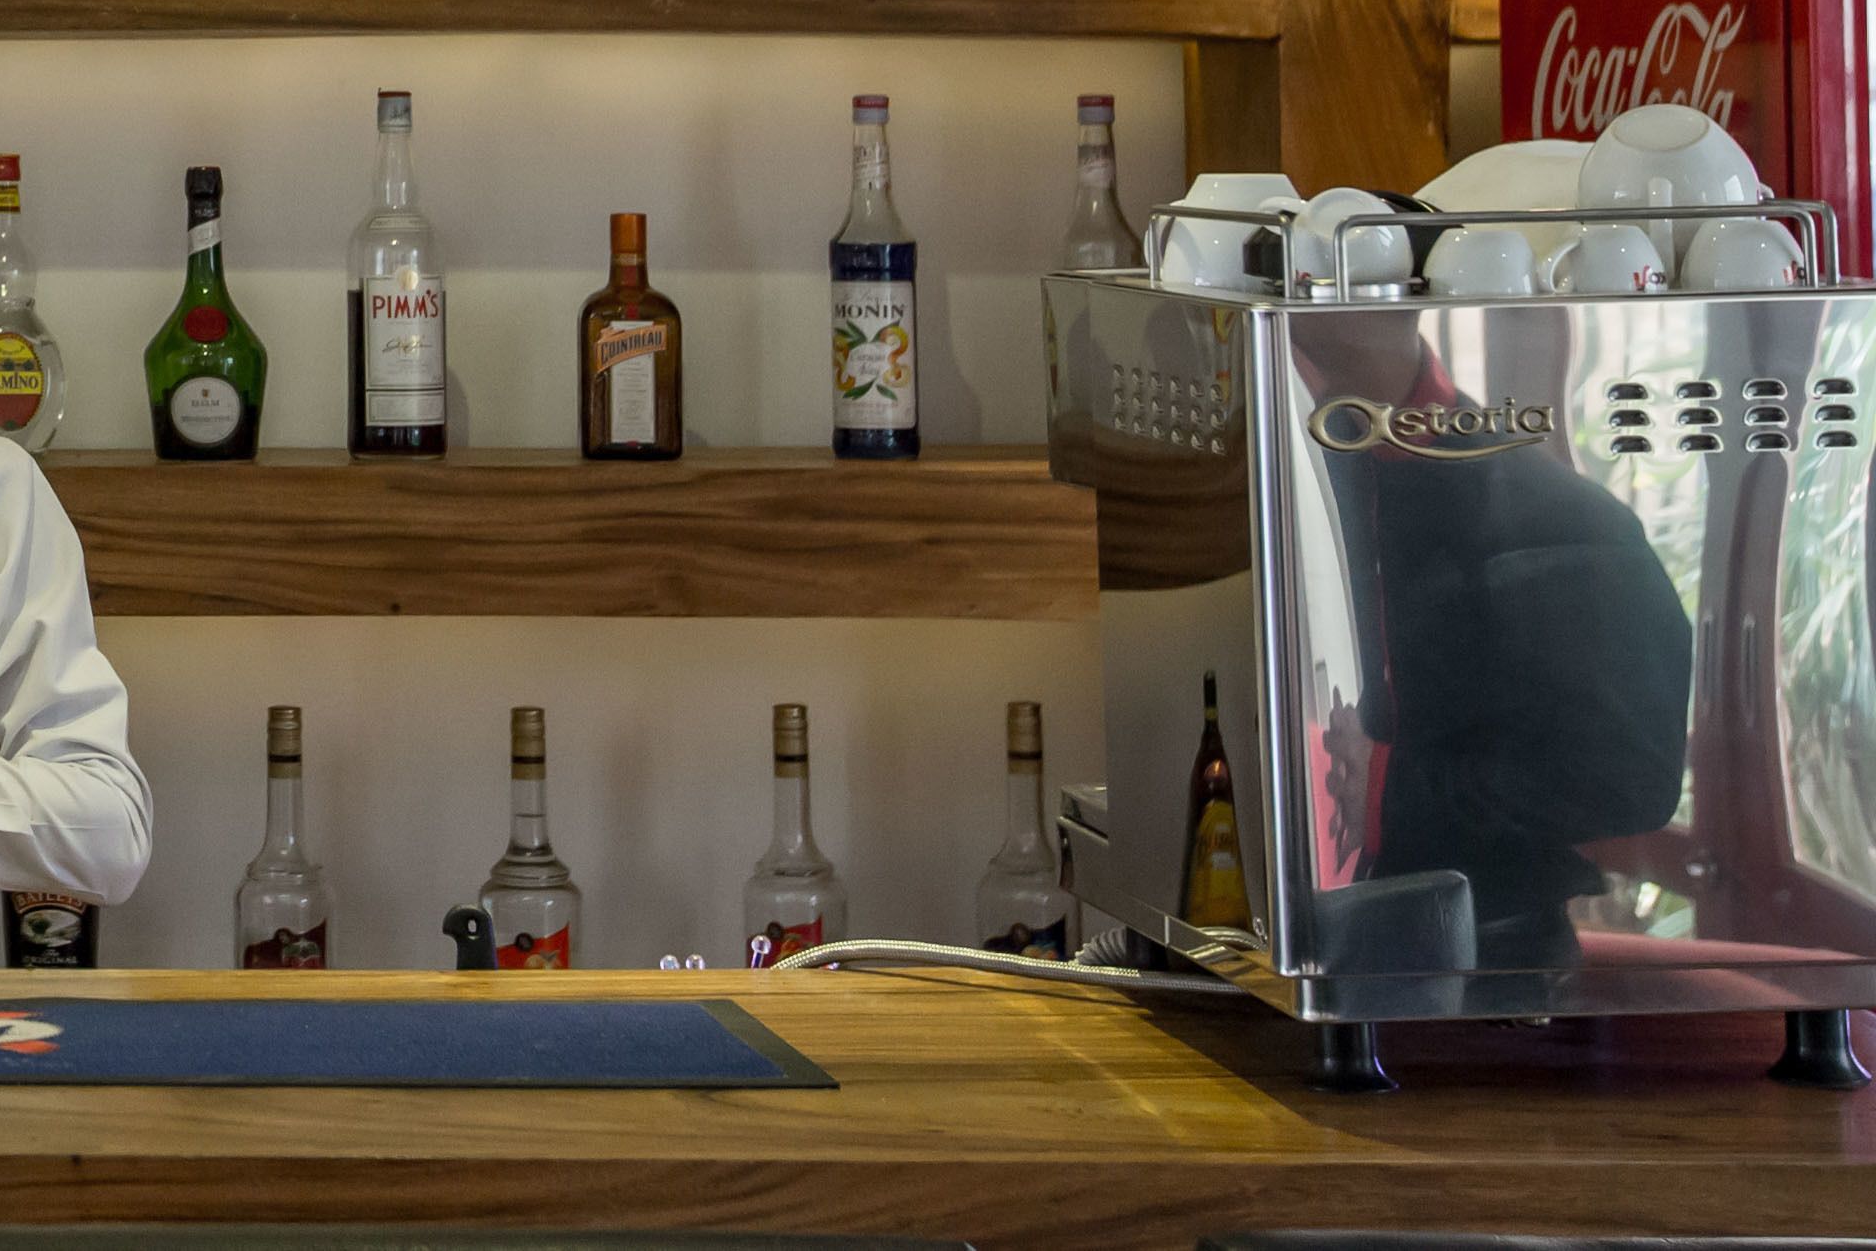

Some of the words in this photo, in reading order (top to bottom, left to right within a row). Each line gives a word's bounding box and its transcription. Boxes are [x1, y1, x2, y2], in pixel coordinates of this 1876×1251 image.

[1532, 2, 1747, 140] Coca-Cla
[371, 289, 439, 319] PIMM'S
[834, 303, 906, 320] MONIN
[601, 330, 663, 366] COINTREAU
